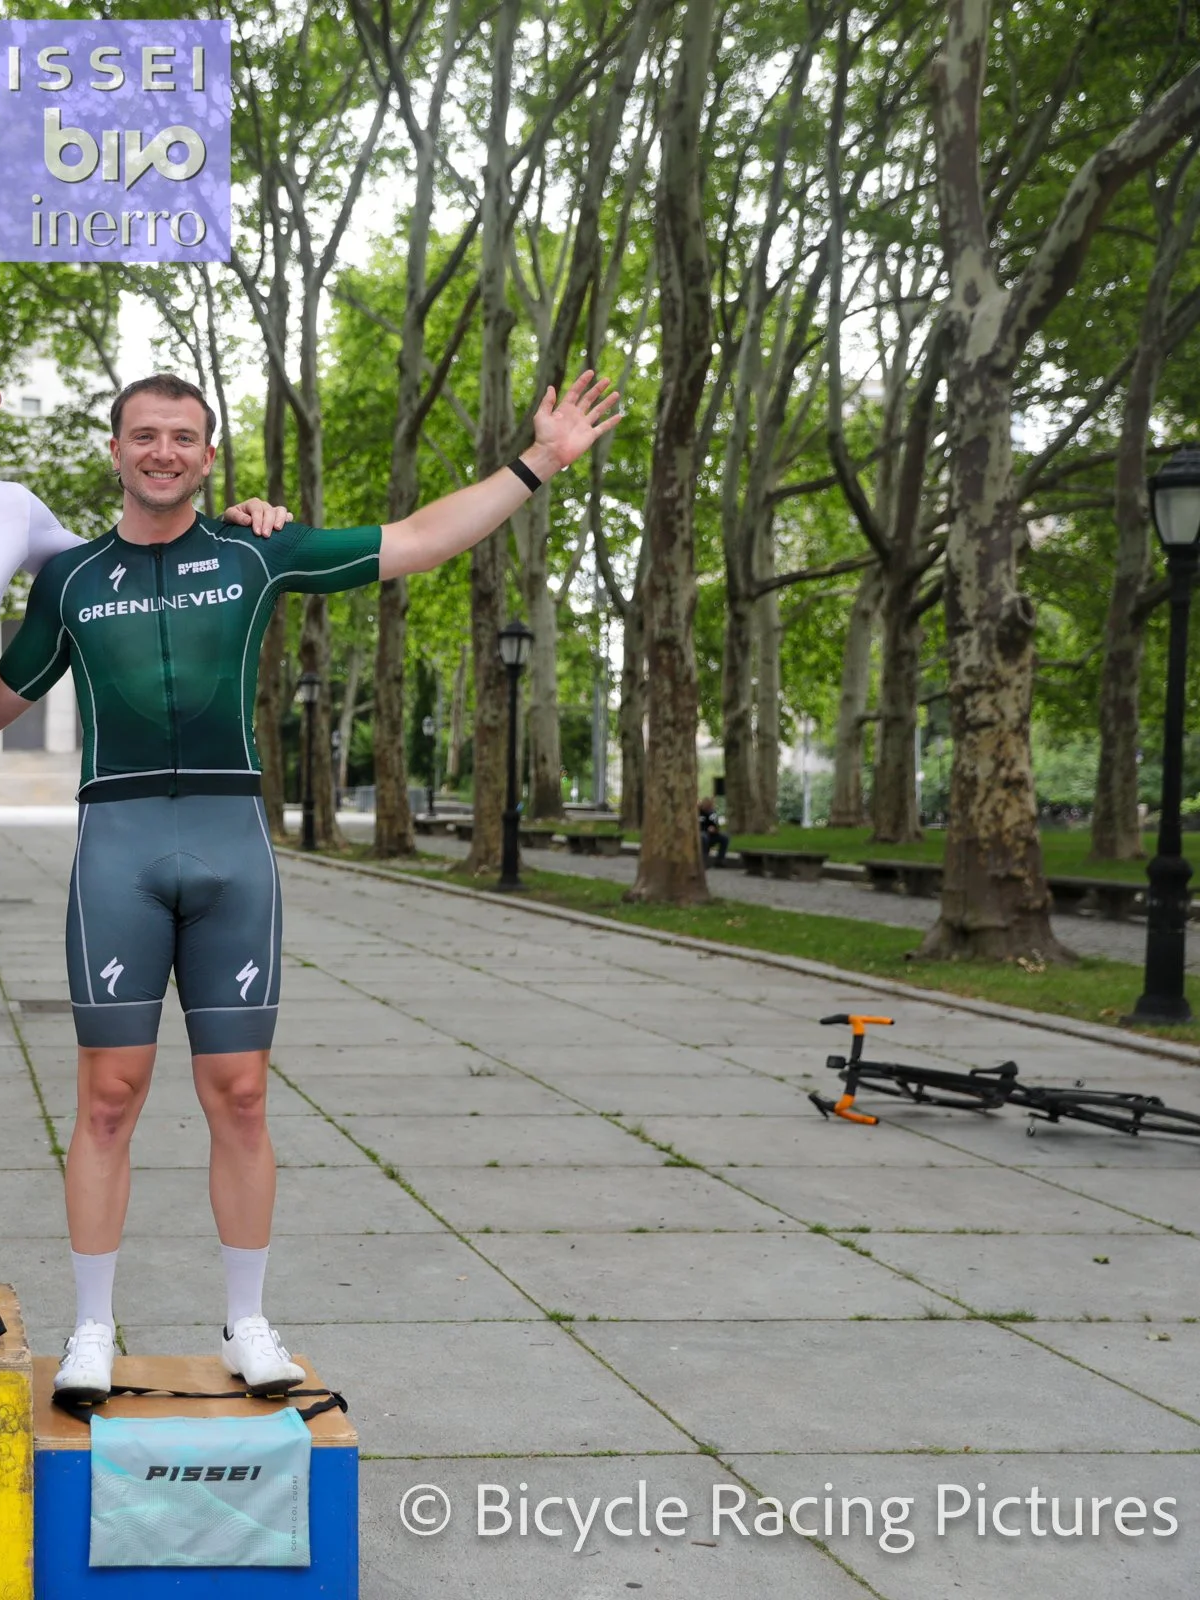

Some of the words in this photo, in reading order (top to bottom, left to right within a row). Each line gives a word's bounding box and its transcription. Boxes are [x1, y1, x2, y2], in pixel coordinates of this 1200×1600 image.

[178, 558, 218, 570] RUBBER
[192, 563, 220, 574] ROAD
[145, 1465, 262, 1482] PISSEI
